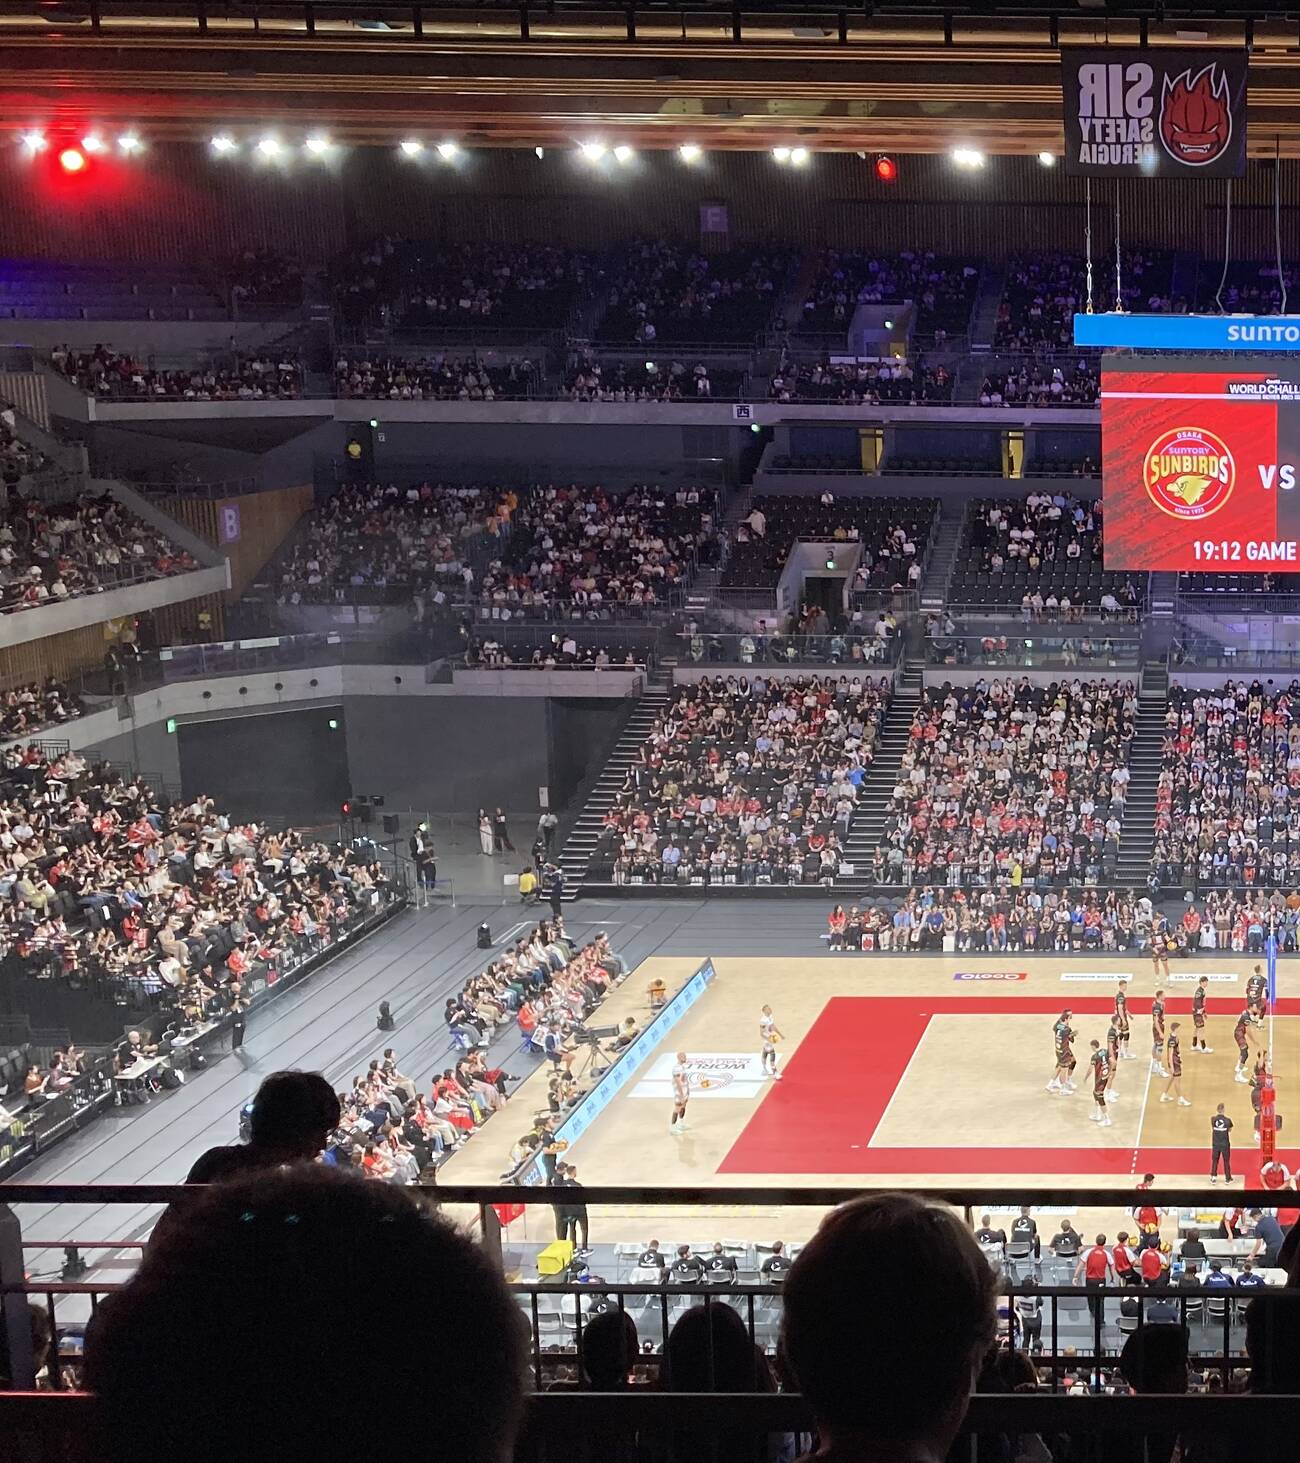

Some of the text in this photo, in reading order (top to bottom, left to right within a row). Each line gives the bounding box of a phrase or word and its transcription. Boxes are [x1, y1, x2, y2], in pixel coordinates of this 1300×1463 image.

[1229, 384, 1267, 394] WORLD
[736, 405, 750, 418] 西
[1150, 455, 1228, 485] SUNBIRDS
[1258, 465, 1296, 490] VS
[224, 509, 237, 538] B
[827, 550, 834, 560] 3
[1193, 541, 1241, 561] 19:12
[1246, 541, 1297, 561] GAME
